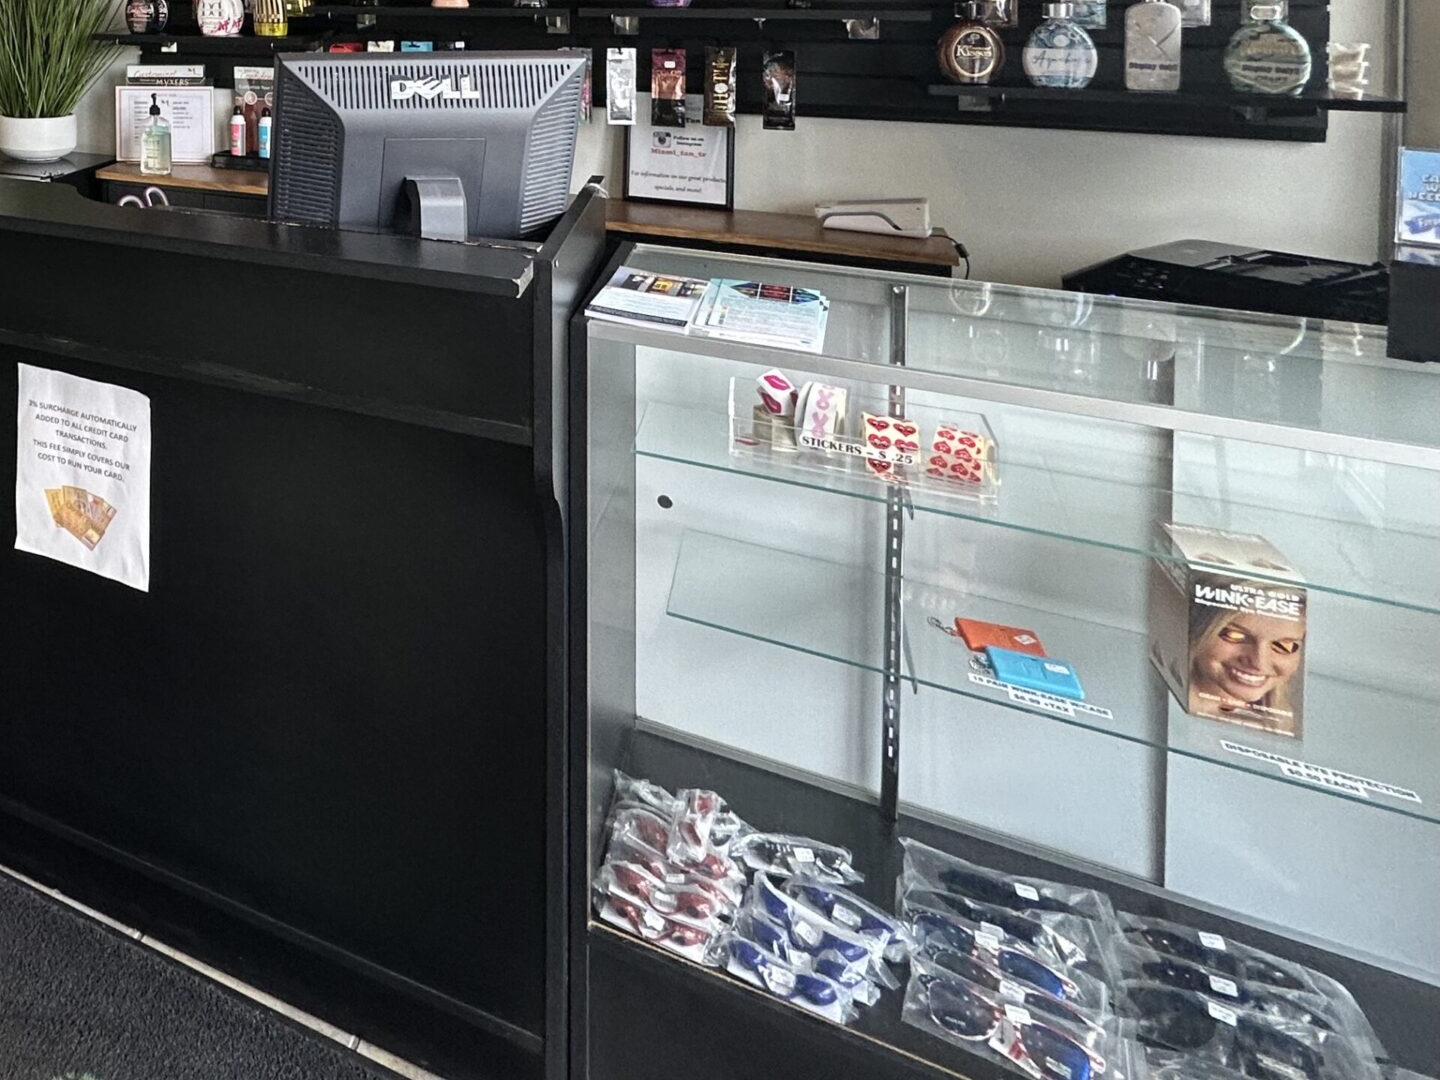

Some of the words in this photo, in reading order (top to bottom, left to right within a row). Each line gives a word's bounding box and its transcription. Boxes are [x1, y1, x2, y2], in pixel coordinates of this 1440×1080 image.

[391, 74, 480, 100] DELL
[36, 414, 59, 424] ADDED
[71, 422, 82, 430] ALL
[84, 426, 108, 437] CREDIT
[109, 432, 129, 443] CARD
[39, 402, 78, 417] SURCHARGE
[81, 412, 137, 432] AUTOMATICALLY
[56, 430, 107, 449] TRANSACTIONS.
[802, 435, 862, 455] STICKERS
[33, 439, 47, 448] THIS
[49, 443, 60, 451] FEE
[62, 446, 85, 457] SIMPLY
[87, 453, 113, 466] COVERS
[115, 461, 130, 471] OUR
[38, 453, 55, 462] COST
[57, 456, 66, 464] TO
[68, 459, 82, 469] RUN
[84, 464, 102, 474] YOUR
[104, 470, 124, 482] CARD.
[1231, 584, 1264, 596] ULTRA
[1268, 591, 1299, 601] GOLD
[1225, 743, 1300, 767] DISPOSABLE
[1304, 764, 1328, 775] EYE
[1332, 772, 1415, 798] PROTECTION
[1324, 778, 1360, 792] EACH
